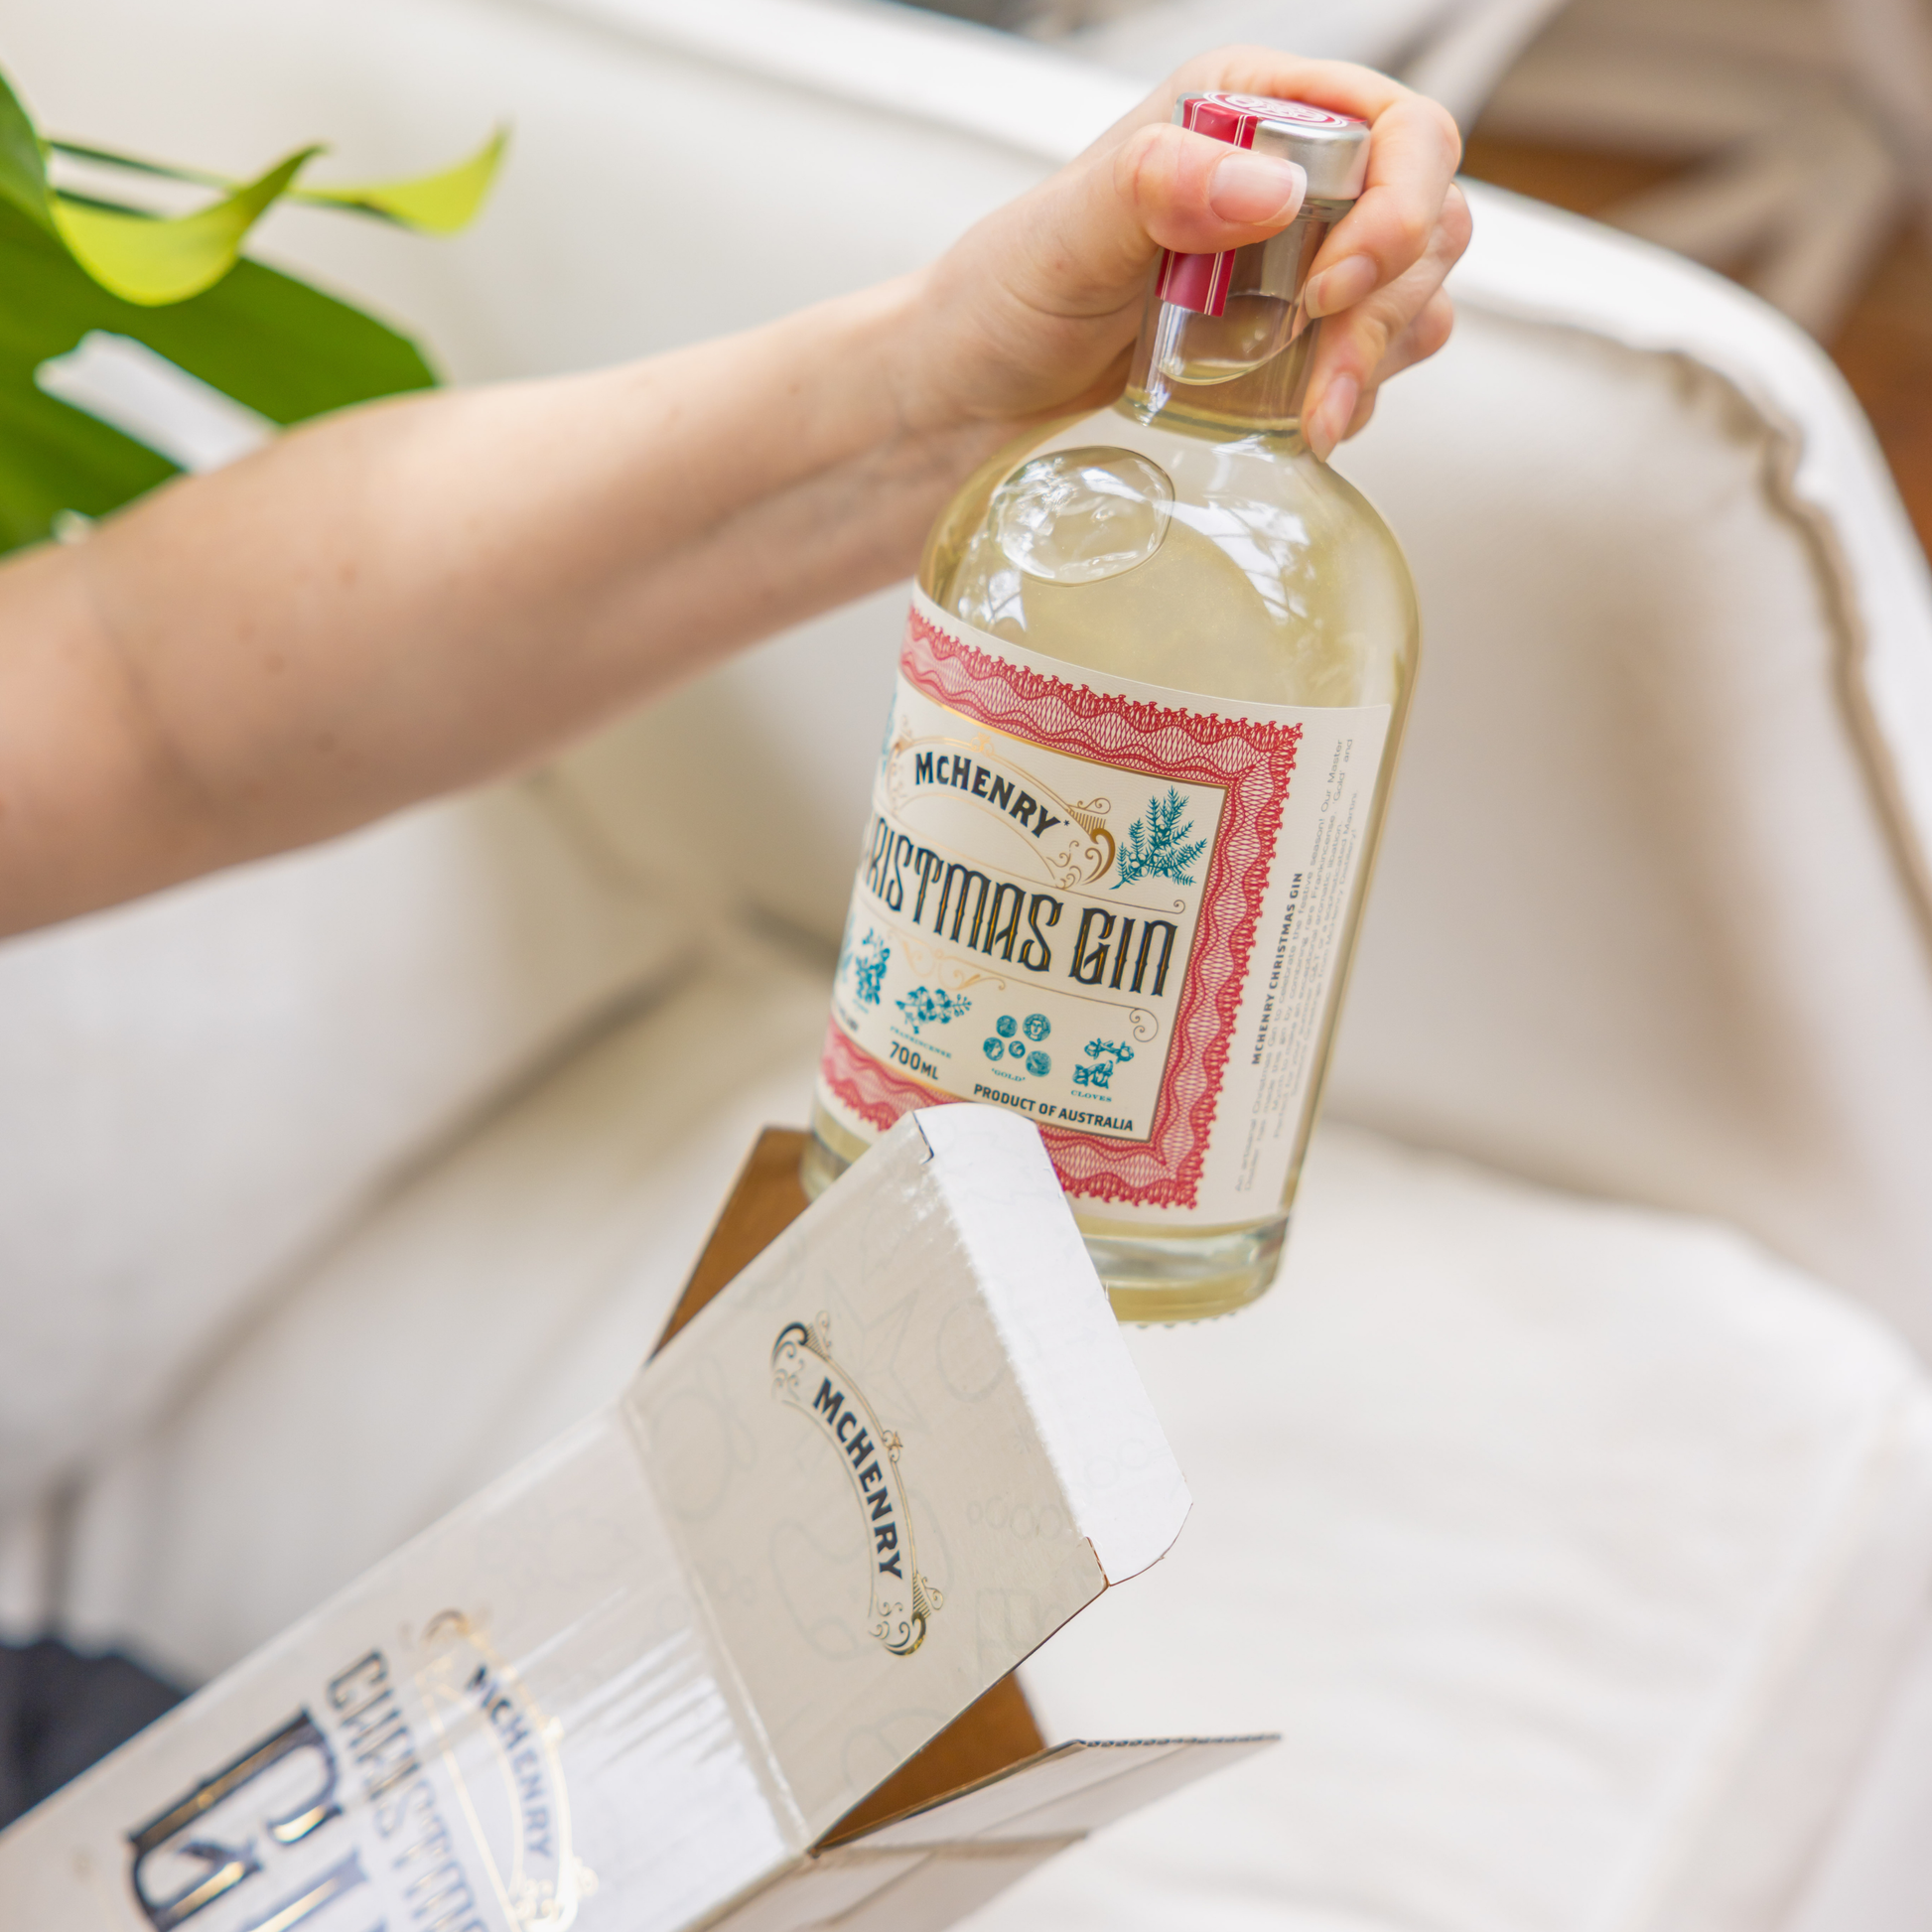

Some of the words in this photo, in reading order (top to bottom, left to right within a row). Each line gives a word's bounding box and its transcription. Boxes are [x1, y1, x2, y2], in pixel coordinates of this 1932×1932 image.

[1326, 739, 1342, 783] Master
[864, 816, 1064, 972] RISTMAS
[1067, 907, 1178, 997] GIN
[1252, 994, 1274, 1065] MCHENRY
[1269, 902, 1295, 990] CHRISTMAS
[1289, 873, 1302, 899] GIN
[973, 1083, 1036, 1112] PRODUCT
[1038, 1103, 1057, 1116] OF
[1057, 1107, 1134, 1132] AUSTRALIA
[1070, 1090, 1113, 1103] CLOVES
[325, 1648, 489, 1932] CHRISTM
